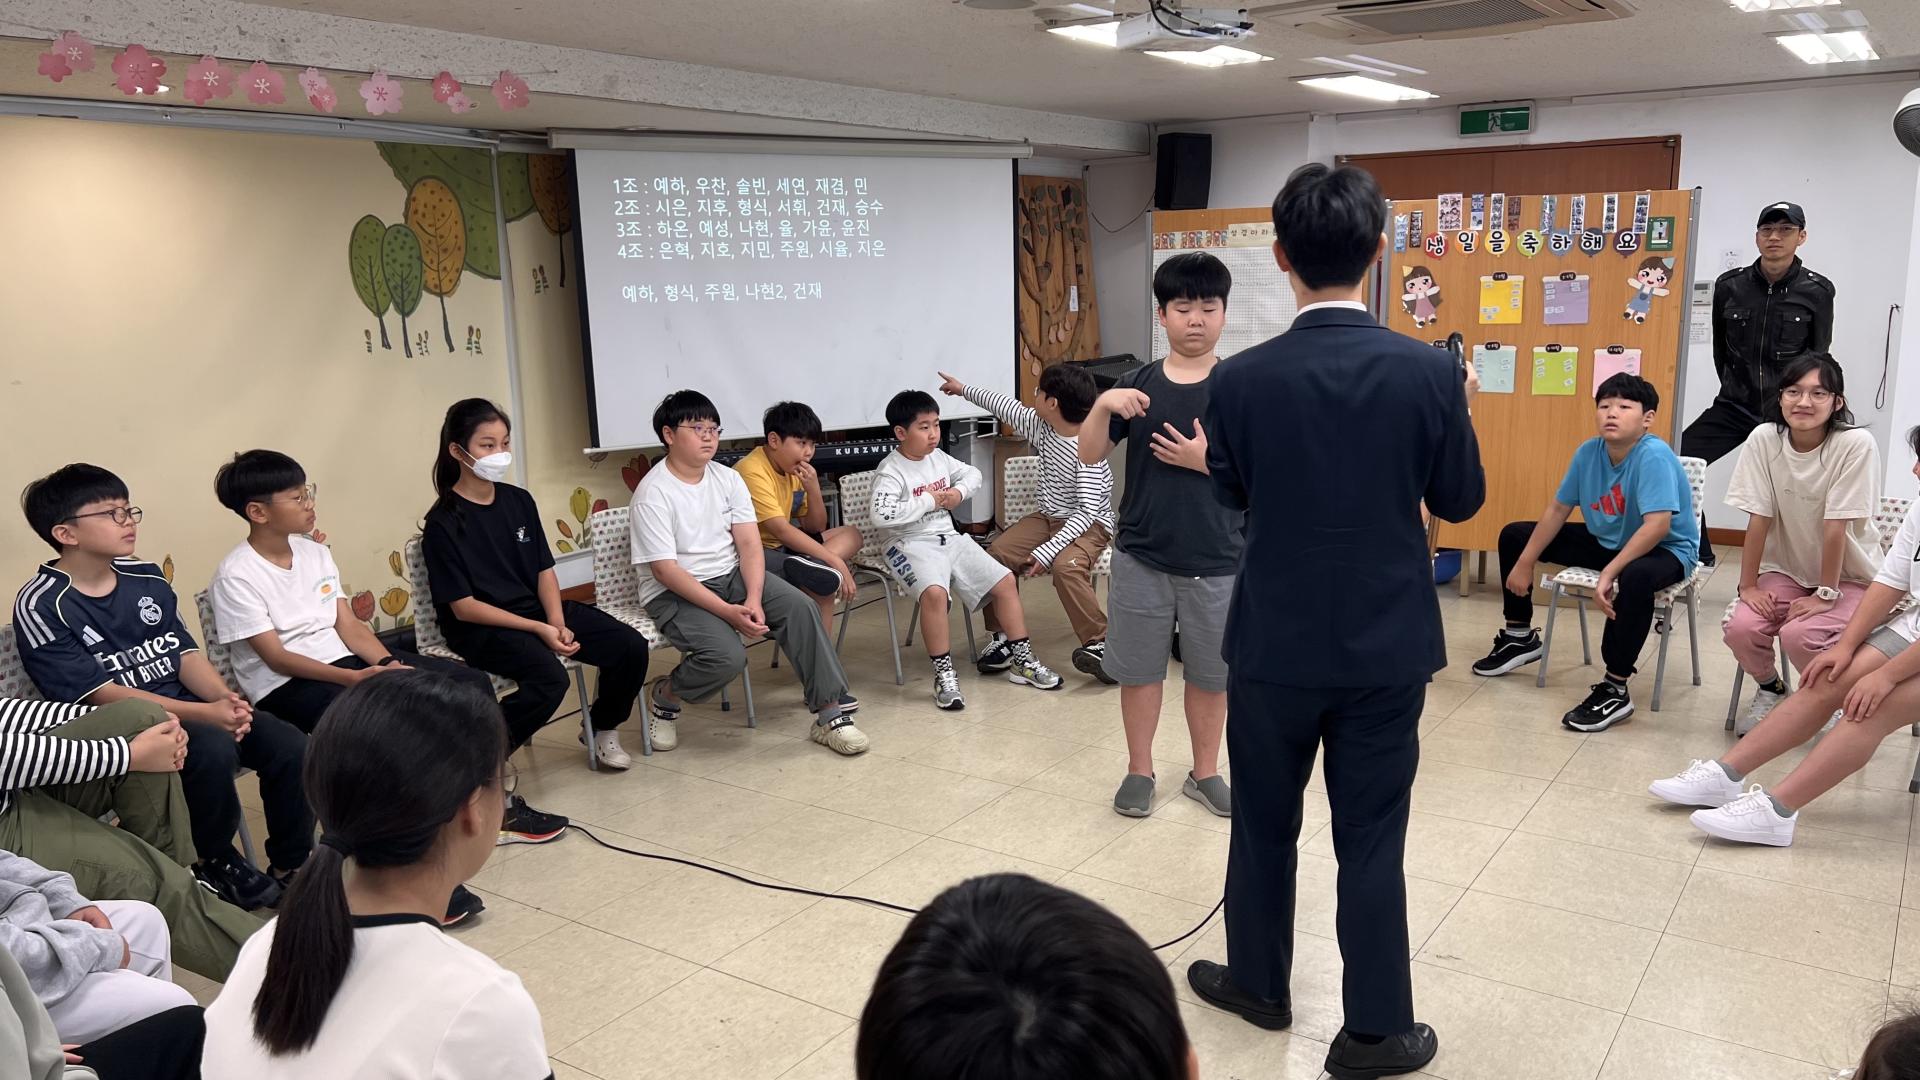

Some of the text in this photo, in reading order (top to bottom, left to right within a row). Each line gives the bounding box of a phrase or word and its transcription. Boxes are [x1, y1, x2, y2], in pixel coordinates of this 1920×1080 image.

[613, 178, 639, 194] 1조
[654, 177, 690, 196] 예하,
[695, 177, 731, 197] 우찬,
[736, 177, 771, 196] 솔빈,
[776, 177, 810, 196] 세연,
[815, 177, 848, 196] 재겸,
[854, 177, 869, 195] 민
[614, 199, 641, 216] 2조
[656, 198, 692, 217] 시은,
[697, 198, 732, 217] 지후,
[737, 198, 772, 217] 형식,
[778, 198, 811, 217] 서휘,
[817, 198, 850, 217] 건재,
[855, 198, 885, 216] 승수
[616, 221, 643, 238] 3조
[656, 220, 693, 239] 하온,
[698, 220, 734, 239] 예성,
[739, 219, 774, 239] 나현,
[778, 219, 797, 238] 율,
[802, 219, 837, 238] 가윤,
[841, 219, 871, 237] 윤진
[617, 243, 644, 259] 4조
[659, 241, 695, 260] 은혁,
[700, 241, 735, 260] 지호,
[740, 241, 775, 260] 지민,
[780, 240, 814, 259] 주원,
[819, 240, 853, 259] 시율,
[857, 239, 887, 257] 지은
[1426, 230, 1638, 256] 생일을 축하해요
[622, 282, 822, 303] 예하, 형식, 주원, 나현2, 건재
[835, 445, 899, 456] KURZWEI
[138, 656, 175, 683] BTTER
